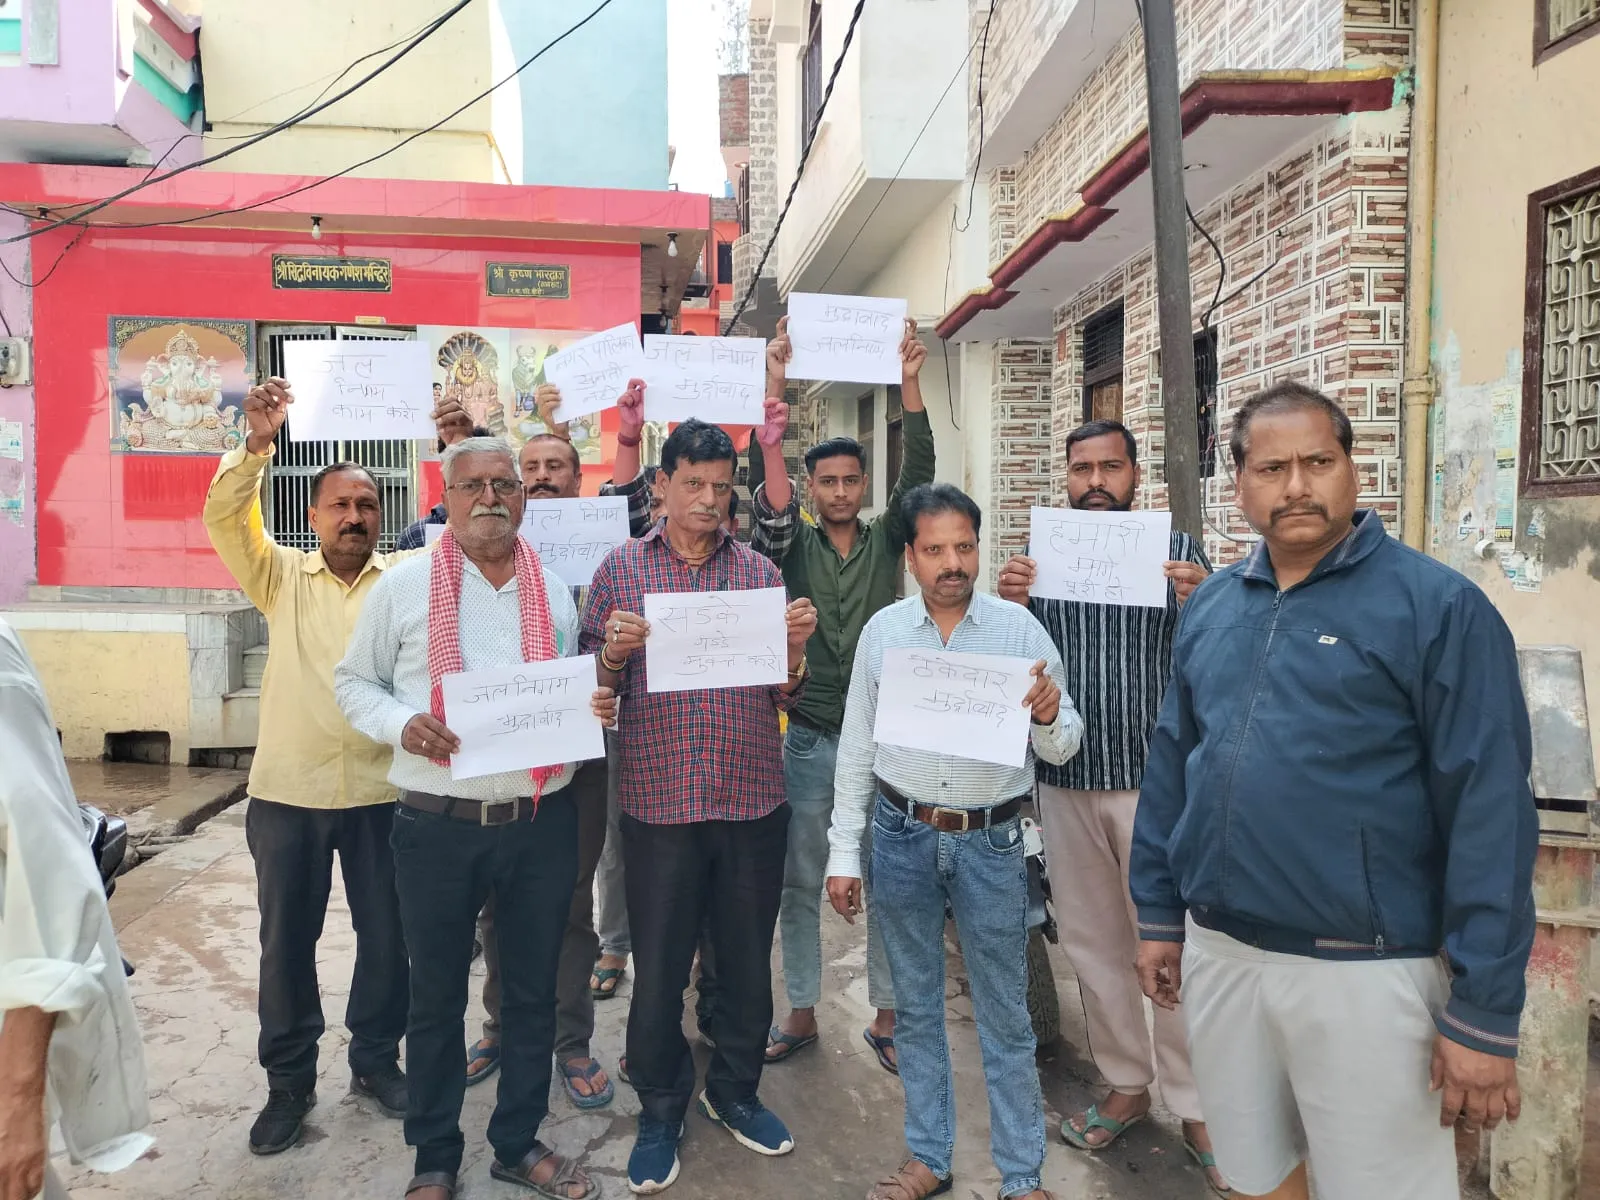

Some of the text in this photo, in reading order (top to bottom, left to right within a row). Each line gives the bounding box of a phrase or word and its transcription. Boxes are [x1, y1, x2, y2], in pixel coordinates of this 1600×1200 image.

[340, 261, 364, 282] गणेश
[493, 265, 505, 279] श्री
[508, 268, 533, 282] कृष्ण
[311, 354, 388, 379] जल
[645, 341, 701, 370] जल
[331, 400, 420, 424] काम करो
[579, 501, 626, 522] निगम
[1047, 519, 1146, 556] हमारी
[745, 645, 784, 673] करो
